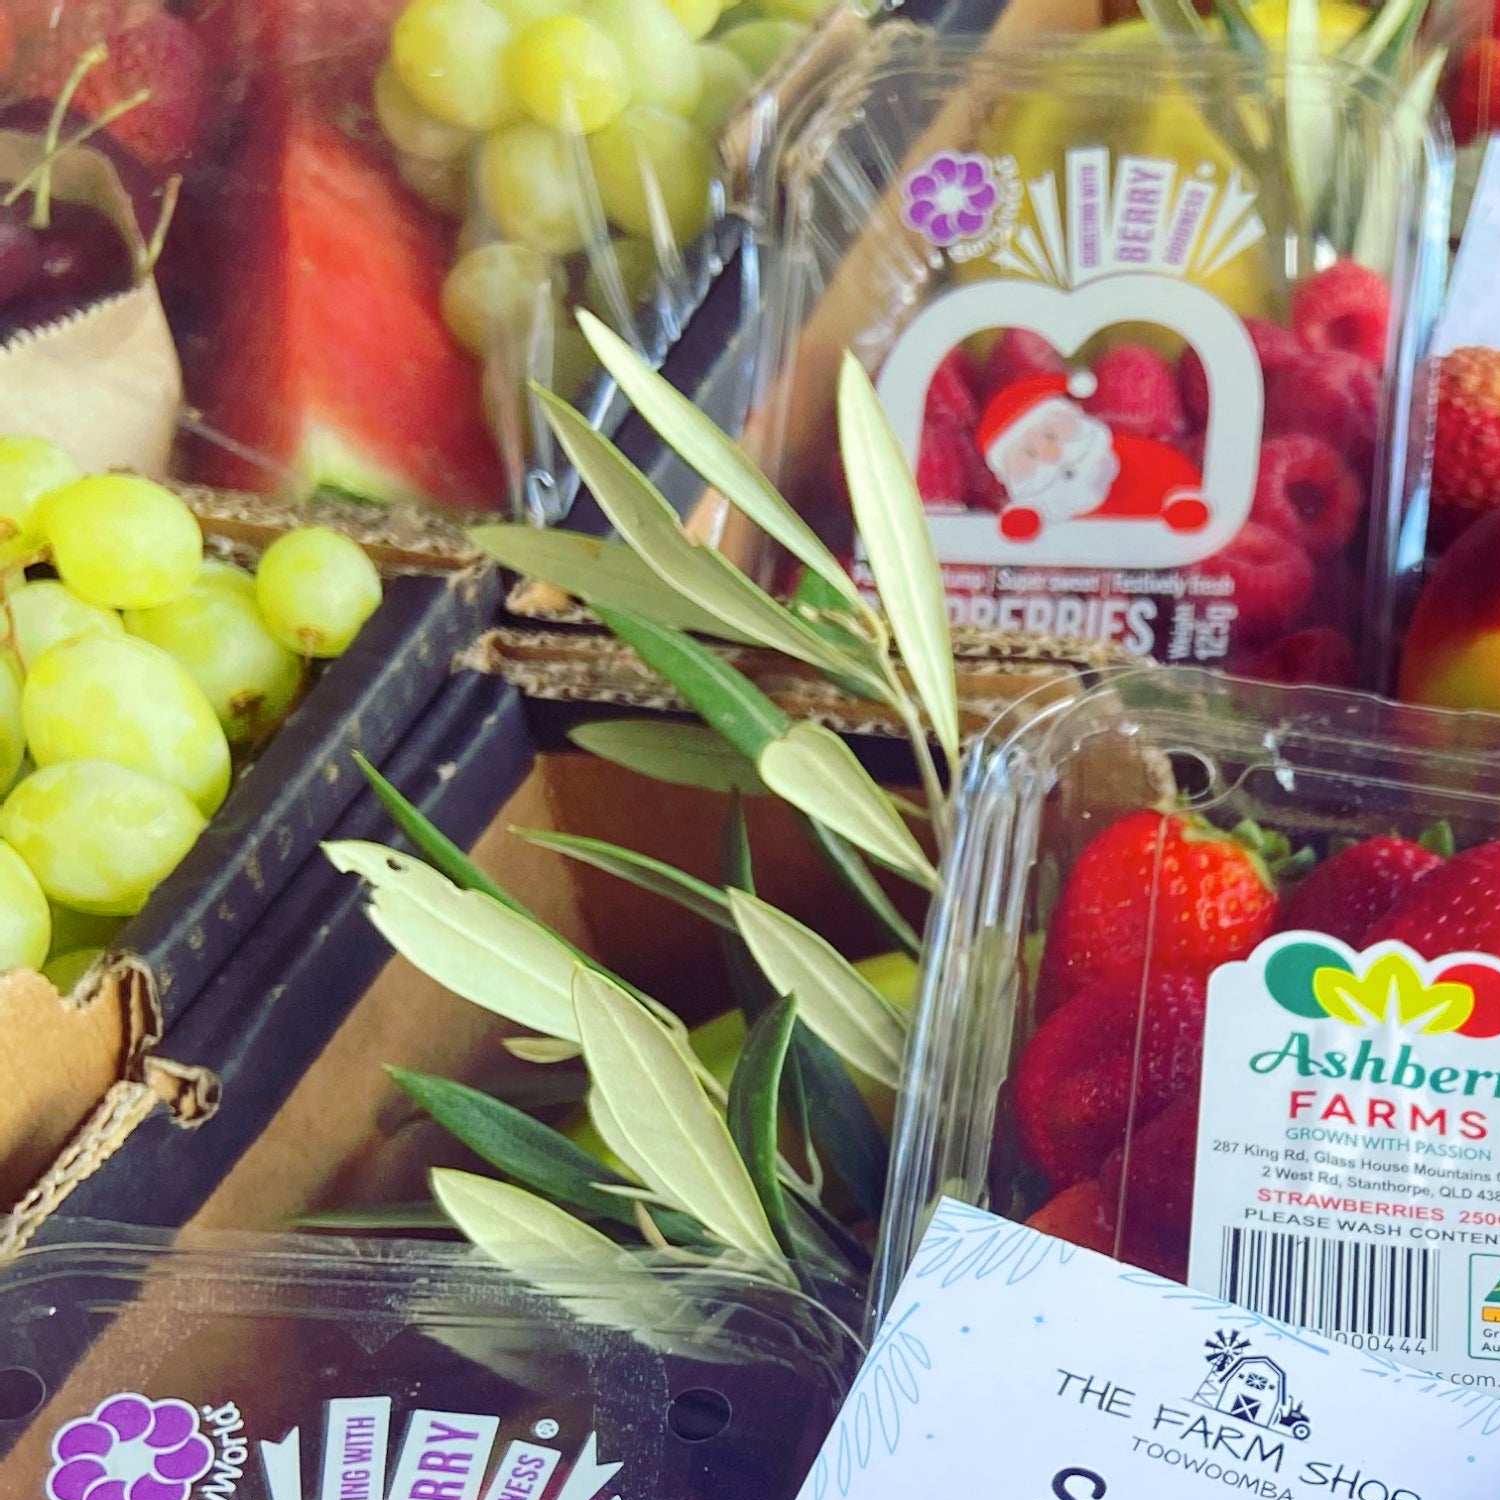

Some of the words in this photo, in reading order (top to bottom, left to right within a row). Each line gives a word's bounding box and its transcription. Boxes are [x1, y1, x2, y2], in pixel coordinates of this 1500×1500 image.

[1116, 167, 1164, 263] BERRY
[999, 570, 1048, 594] Super
[1288, 1090, 1488, 1140] FARMS
[1212, 1139, 1240, 1152] 287
[1244, 1143, 1280, 1162] King
[1284, 1149, 1309, 1164] Rd,
[1314, 1151, 1356, 1169] Glass
[1361, 1159, 1409, 1173] House
[1414, 1163, 1492, 1183] Mountains
[1286, 1127, 1357, 1149] GROWN
[1363, 1136, 1410, 1152] WITH
[1416, 1141, 1492, 1162] PASSION
[1261, 1165, 1271, 1178] 2
[1275, 1167, 1314, 1182] West
[1317, 1171, 1343, 1188] Rd,
[1347, 1176, 1435, 1198] Stanthorpe,
[1439, 1186, 1473, 1200] QLD
[1244, 1207, 1331, 1230] PLEASE
[1336, 1218, 1401, 1238] WASH
[1257, 1187, 1445, 1221] STRAWBERRIES
[1056, 1367, 1136, 1419] THE
[1153, 1403, 1285, 1473] FARM
[343, 1416, 376, 1465] WITH
